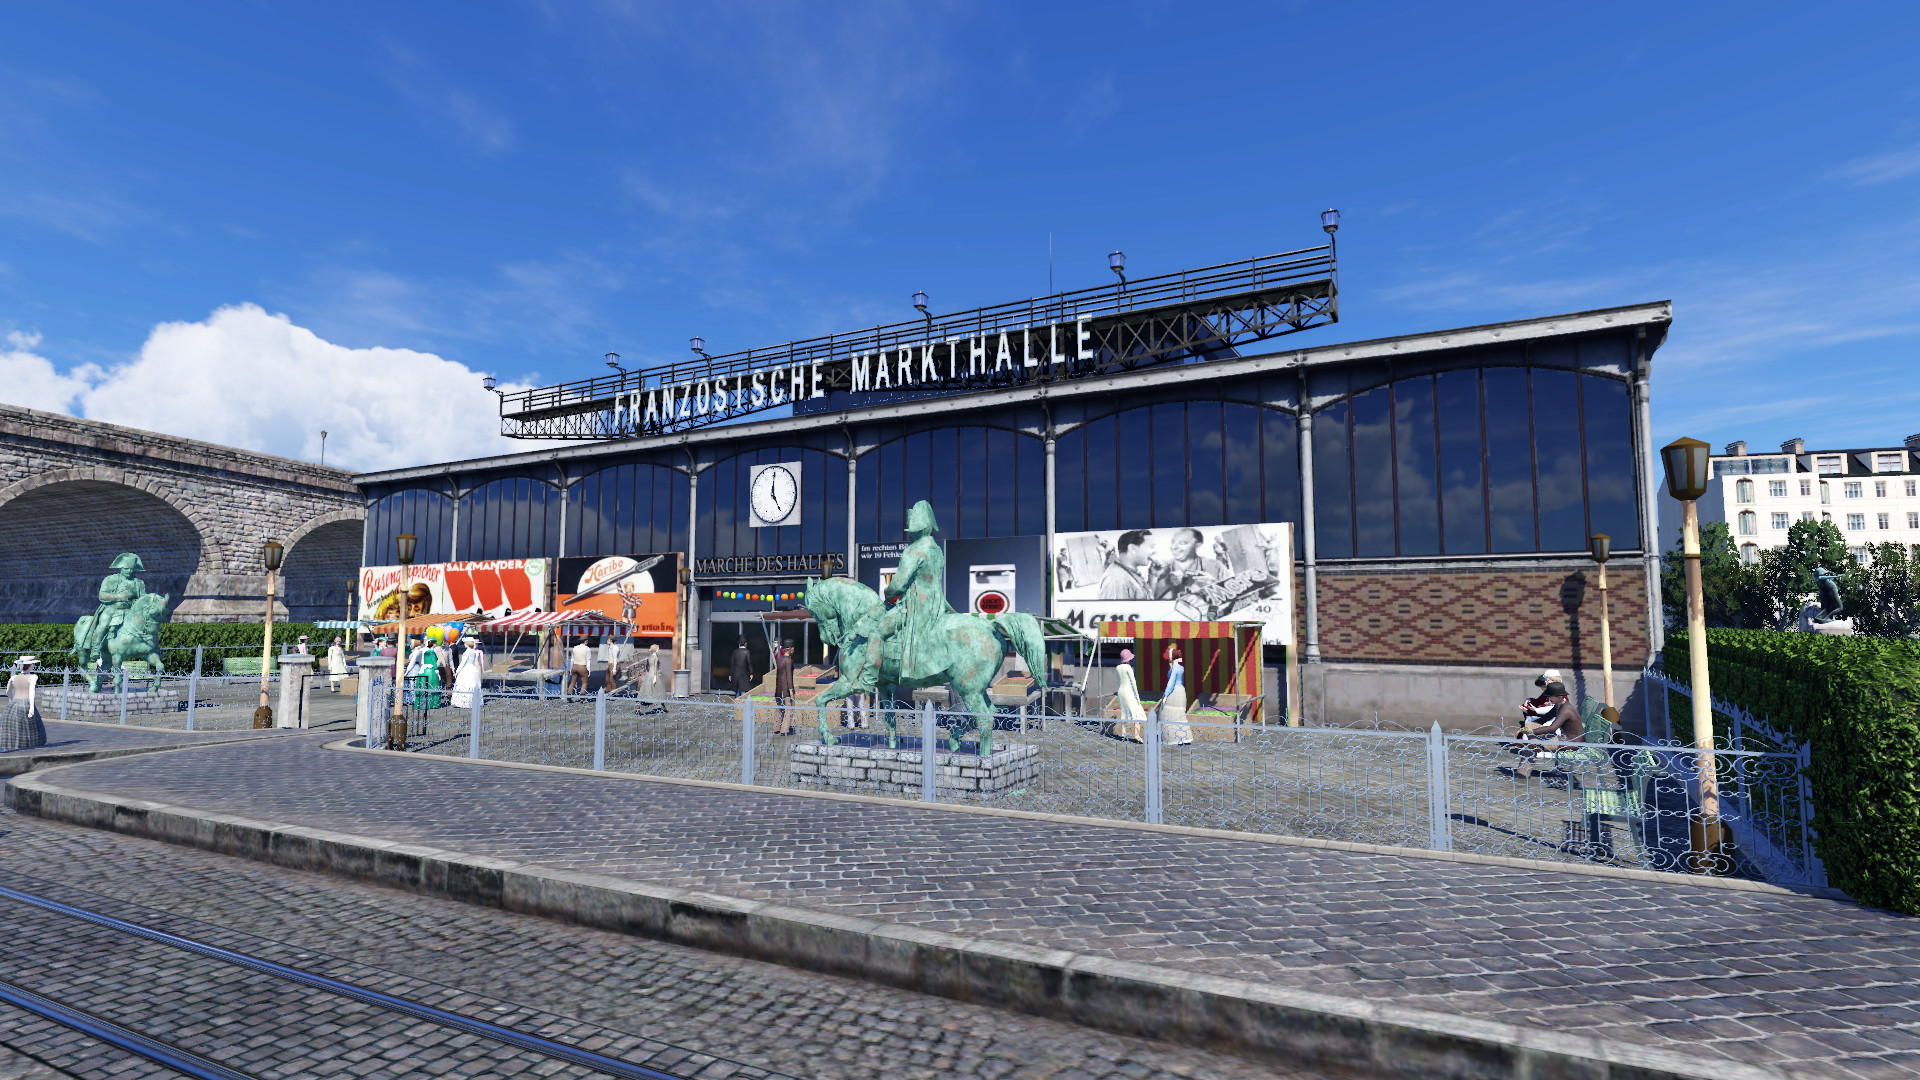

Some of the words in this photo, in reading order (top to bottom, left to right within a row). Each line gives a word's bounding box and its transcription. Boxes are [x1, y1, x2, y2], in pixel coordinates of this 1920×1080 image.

[850, 313, 1094, 393] MARKTHALLE
[446, 560, 525, 572] SALAMANDER
[584, 559, 624, 584] Haribo
[756, 554, 784, 573] DES
[1255, 605, 1271, 613] 40
